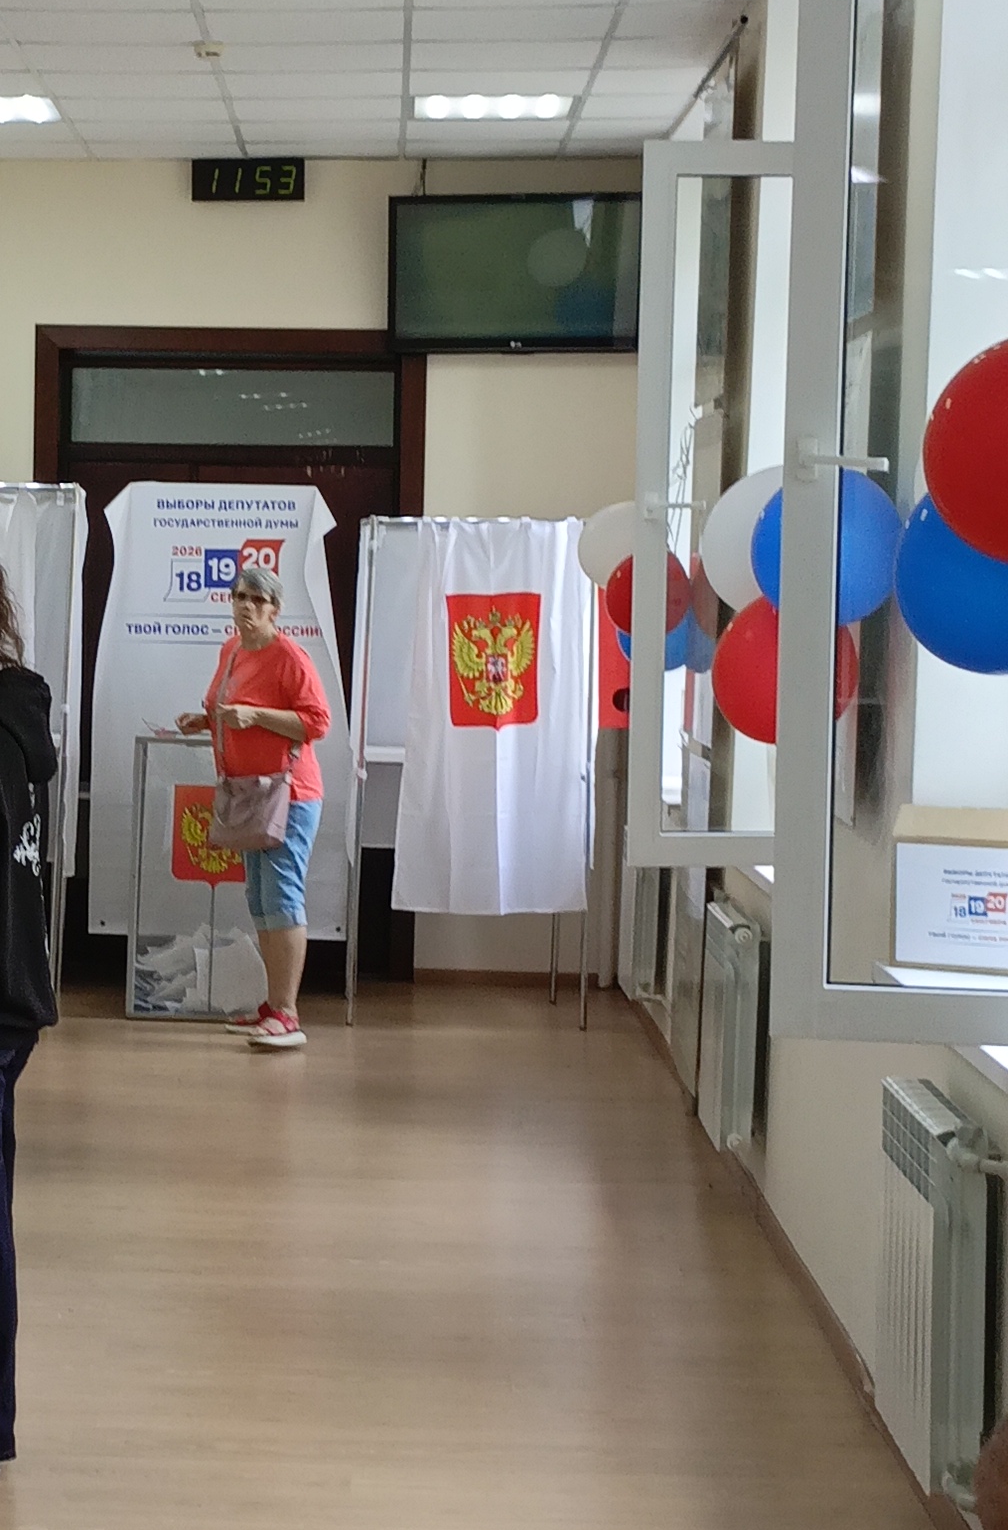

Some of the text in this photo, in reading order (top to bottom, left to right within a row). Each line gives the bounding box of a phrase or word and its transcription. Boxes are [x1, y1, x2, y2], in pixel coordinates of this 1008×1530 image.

[156, 498, 297, 512] ВЫБОРЫ ДЕПУТАТОВ
[153, 517, 299, 529] ГОСУДАРСТВЕННОЙ ДУМЫ
[171, 545, 202, 557] 2026
[242, 547, 276, 570] 20
[207, 557, 237, 582] 19
[175, 570, 203, 593] 18
[125, 622, 162, 636] ТВОЙ
[165, 623, 209, 636] ГОЛОС
